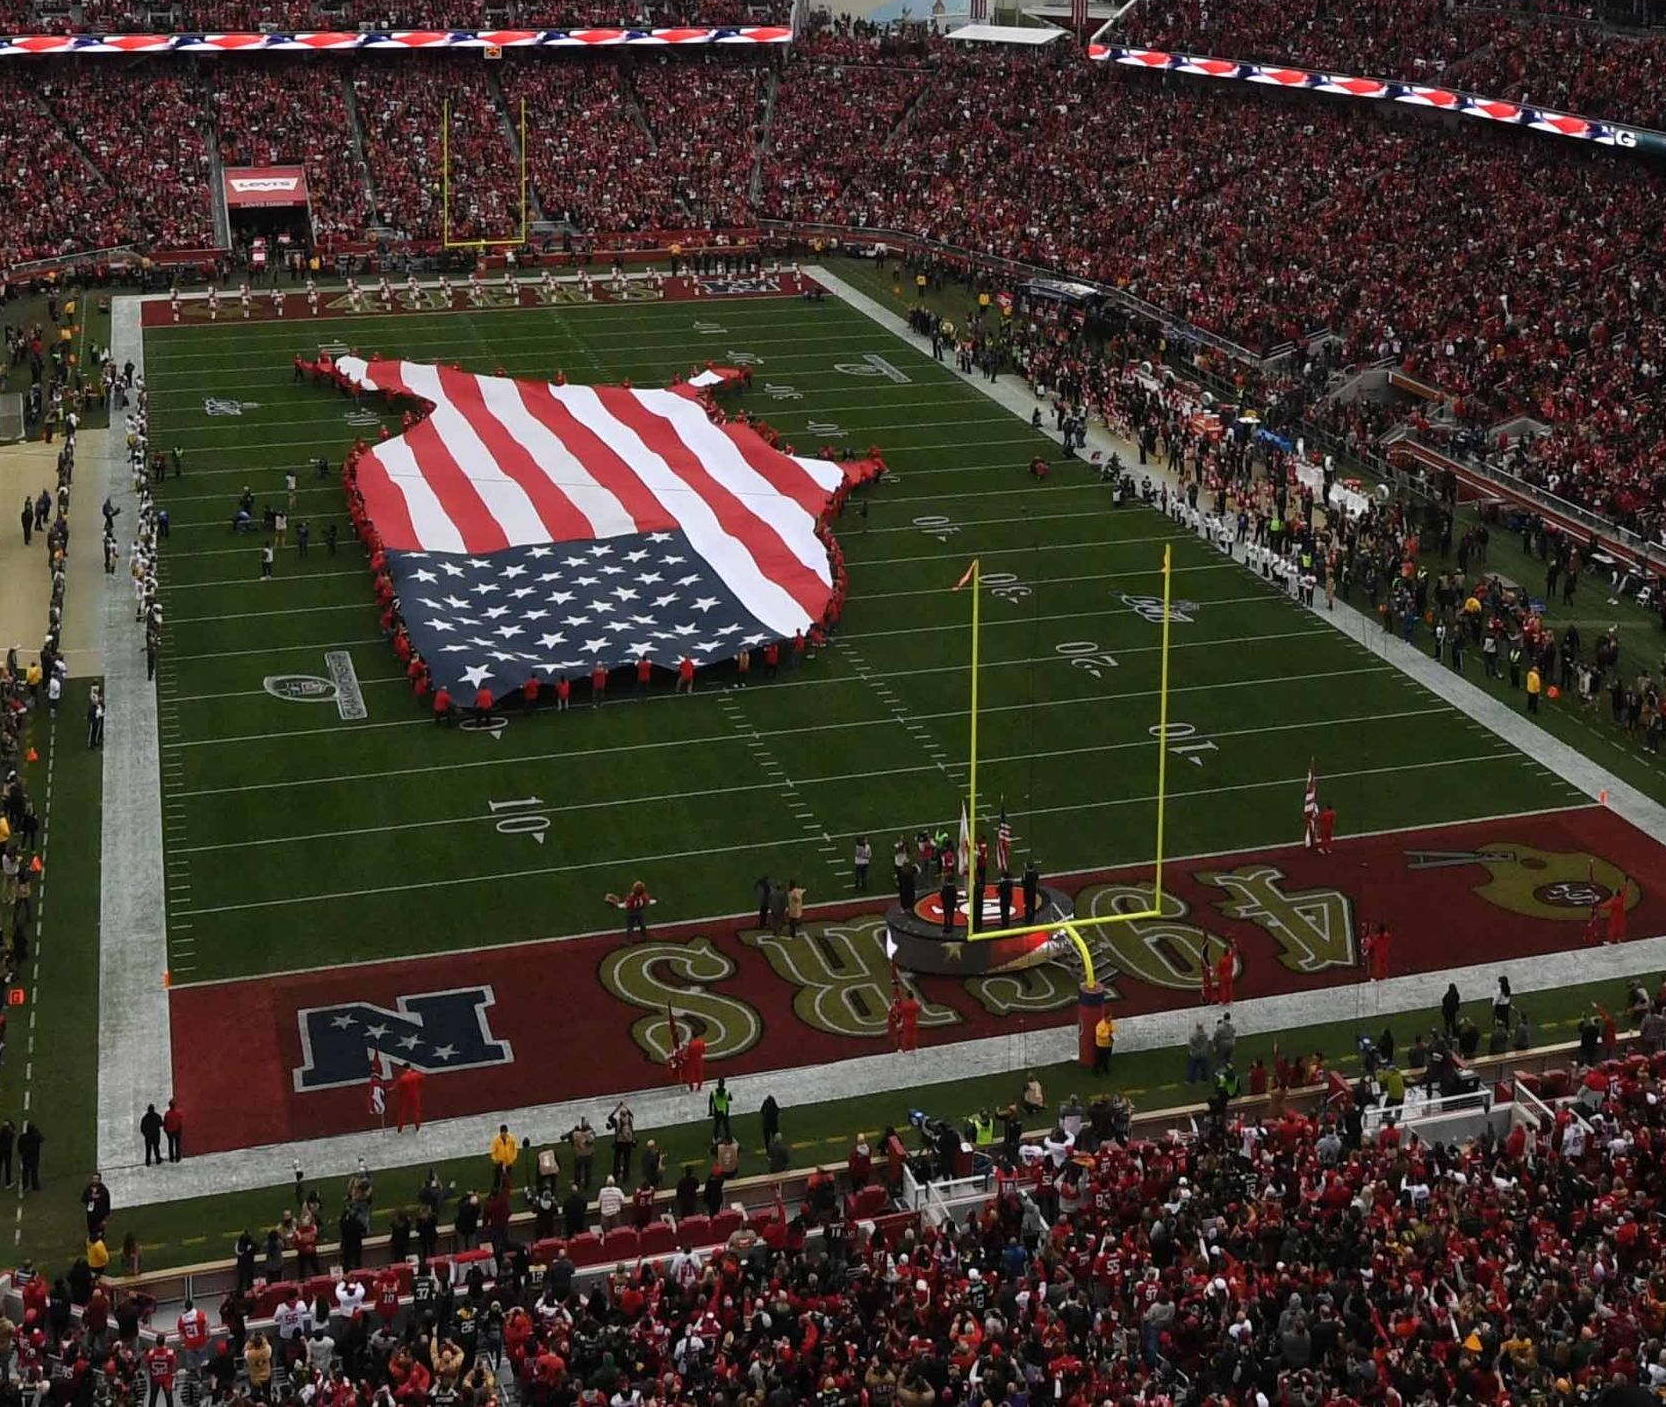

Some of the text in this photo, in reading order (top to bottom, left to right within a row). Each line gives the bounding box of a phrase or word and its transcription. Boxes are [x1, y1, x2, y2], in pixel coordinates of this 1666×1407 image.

[977, 572, 1033, 597] 30
[1055, 641, 1120, 669] 20
[1148, 722, 1220, 756] 10
[487, 795, 551, 833] 10
[598, 864, 1361, 1068] 49RS
[531, 1271, 544, 1284] 12
[1106, 1257, 1120, 1273] 55
[384, 1291, 395, 1305] 10
[416, 1287, 430, 1301] 37
